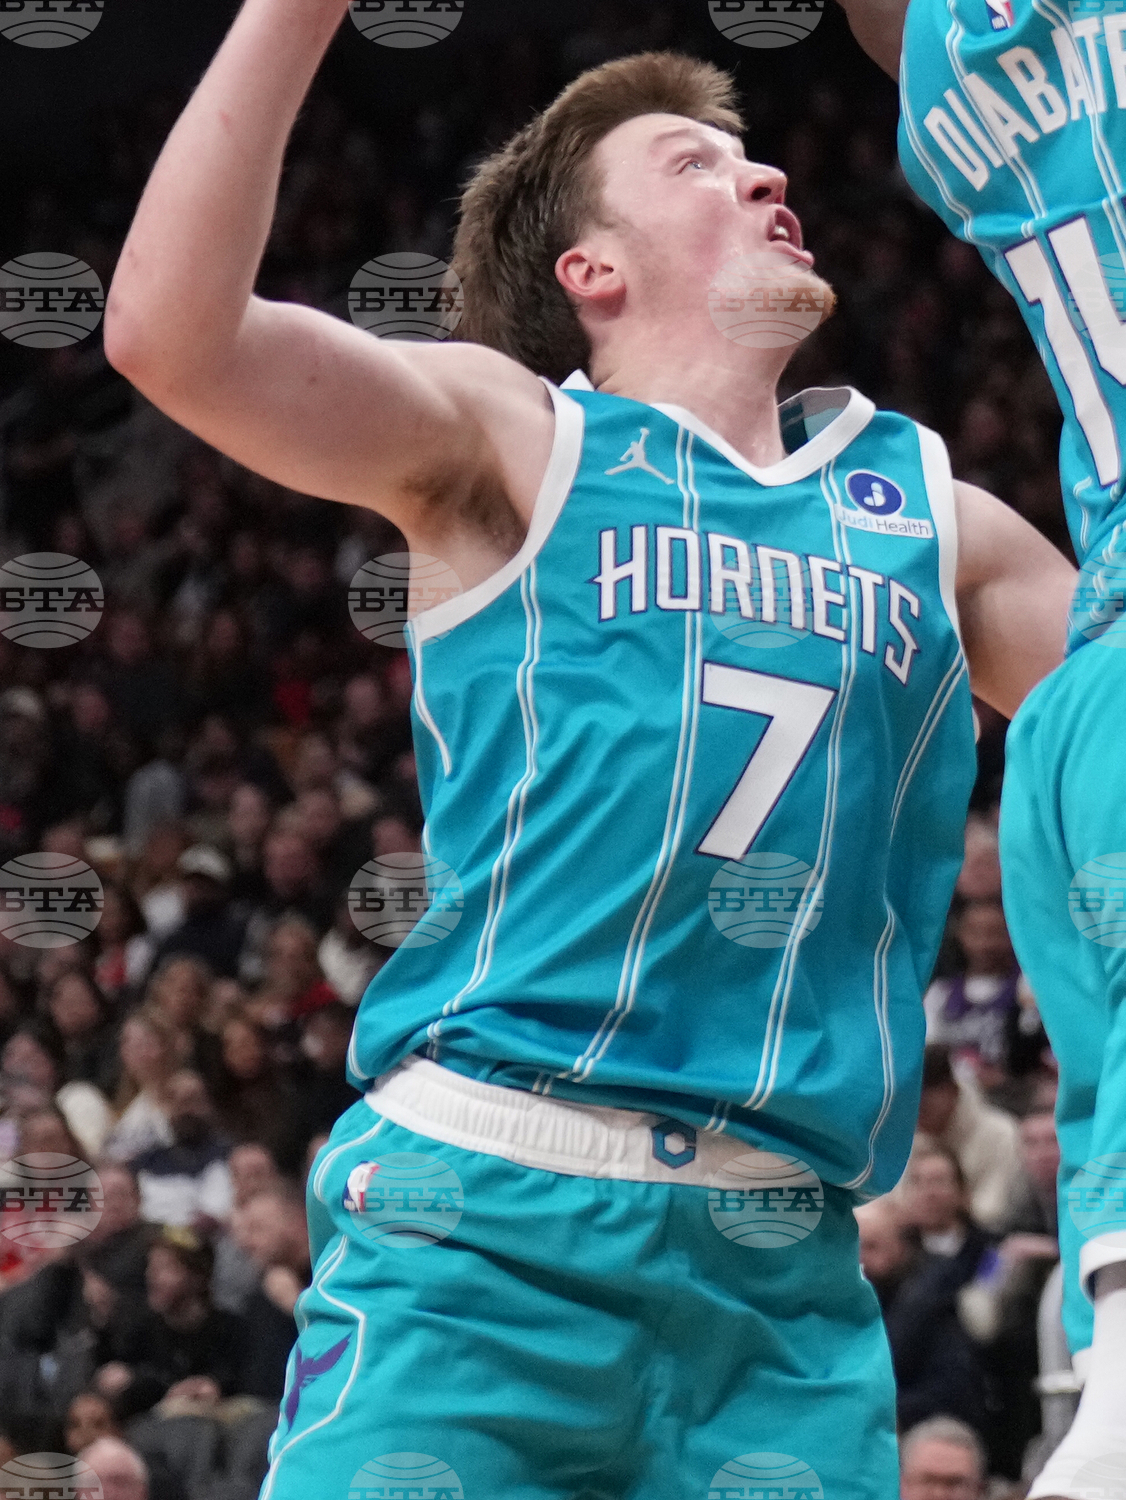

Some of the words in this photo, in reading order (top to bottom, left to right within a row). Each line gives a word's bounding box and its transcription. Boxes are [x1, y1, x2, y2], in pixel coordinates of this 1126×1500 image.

[840, 508, 875, 530] Judi
[875, 518, 929, 536] Health
[586, 523, 922, 687] HORNETS
[693, 659, 840, 862] 7
